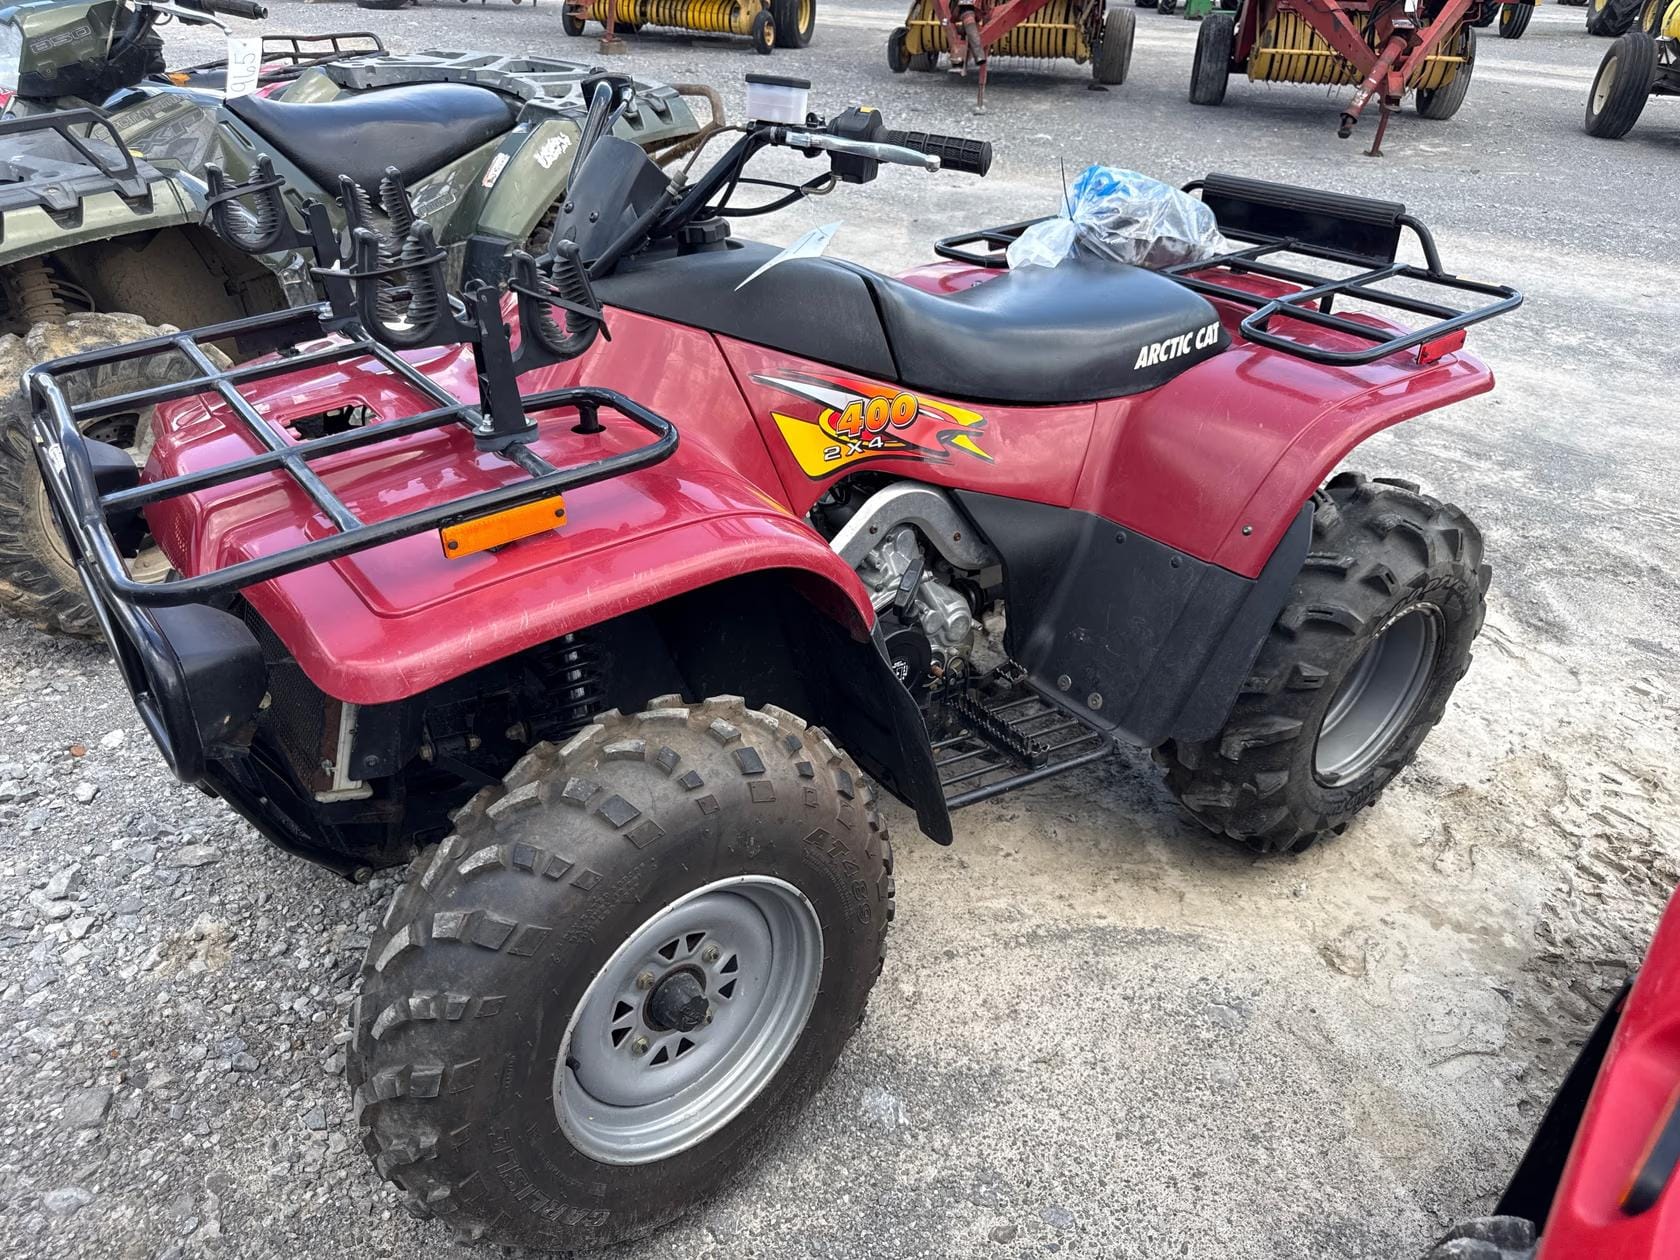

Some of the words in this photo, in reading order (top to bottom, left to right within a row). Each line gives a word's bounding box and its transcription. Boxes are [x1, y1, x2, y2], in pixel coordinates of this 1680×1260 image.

[30, 25, 92, 54] 850
[230, 52, 256, 92] 965
[1133, 331, 1194, 370] ARCTIC
[1195, 321, 1220, 350] CAT
[836, 392, 919, 439] 400
[802, 827, 872, 926] AT489
